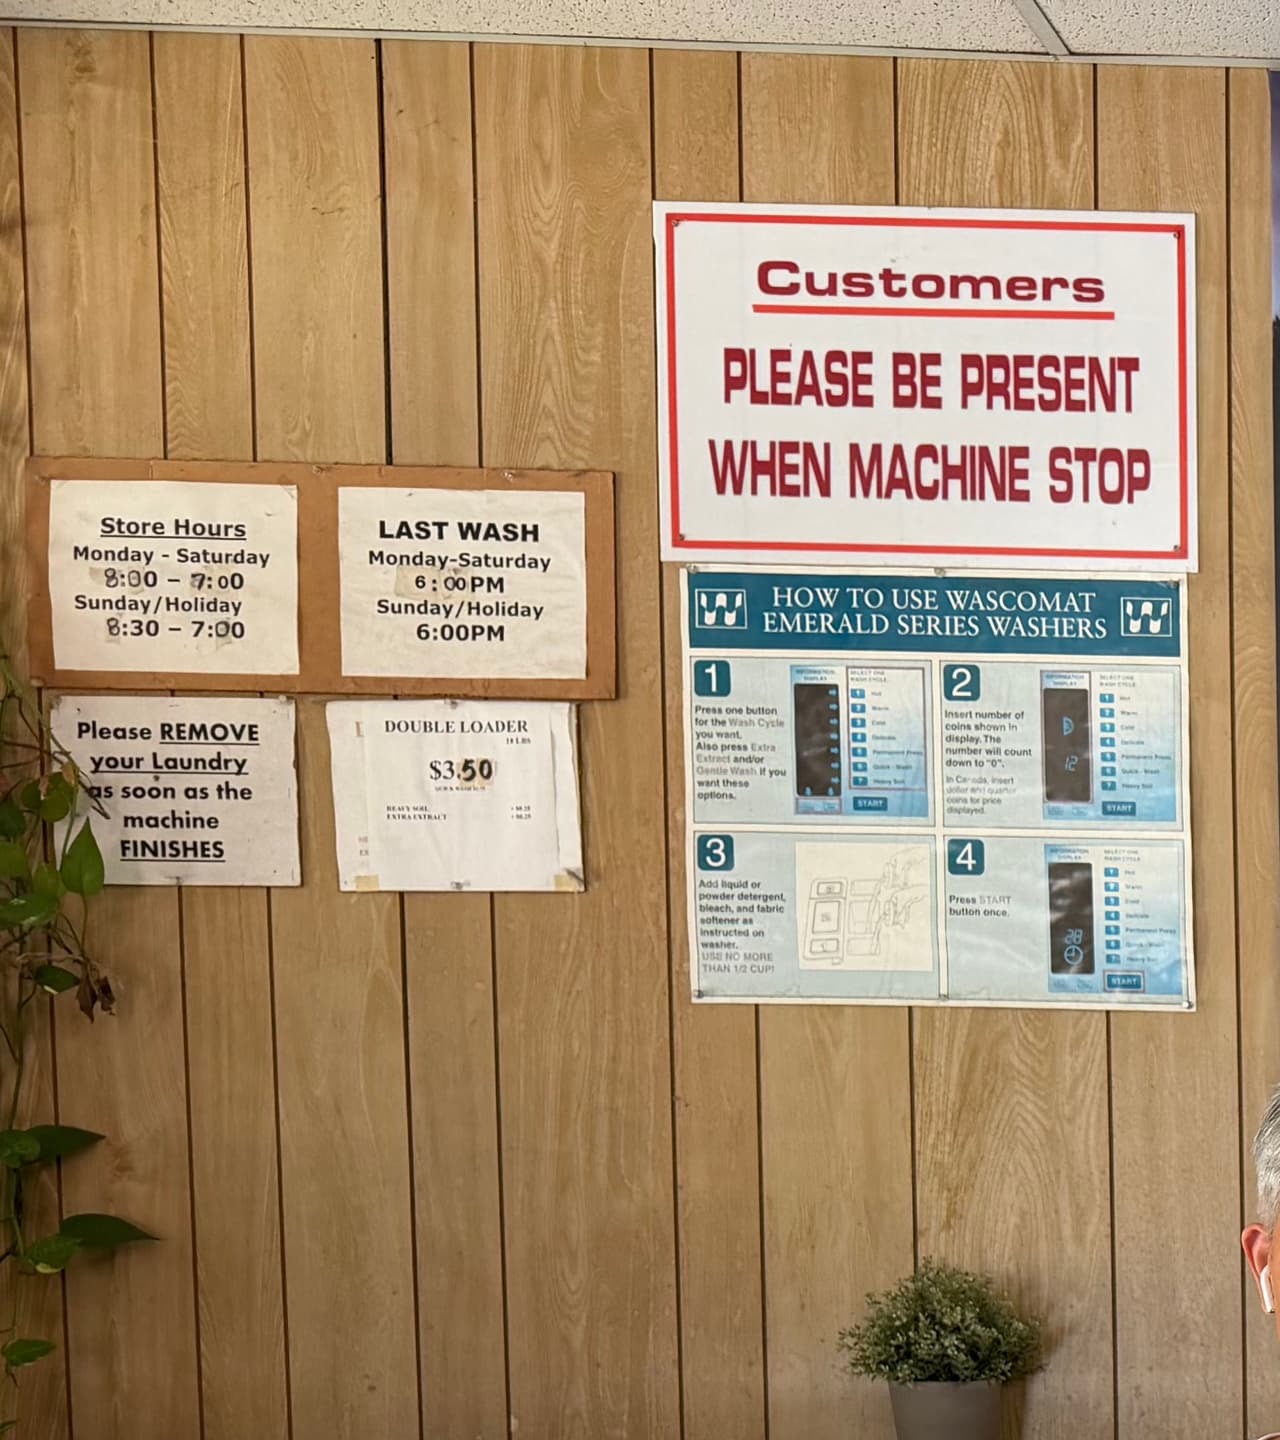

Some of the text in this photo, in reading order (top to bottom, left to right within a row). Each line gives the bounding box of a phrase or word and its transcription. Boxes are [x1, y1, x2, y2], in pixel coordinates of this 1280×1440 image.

[757, 260, 1106, 302] Customers
[723, 347, 1139, 413] PLEASE BE PRESENT
[708, 438, 1151, 504] WHEN MACHINE STOP
[101, 517, 246, 537] Store Hours
[378, 521, 540, 543] LAST WASH
[73, 546, 270, 569] Monday Saturday
[368, 550, 551, 572] Monday-Saturday
[74, 595, 243, 616] Sunday/Holiday
[376, 599, 544, 620] Sunday/Holiday
[772, 586, 1096, 614] HOW TO USE WASCOMAT
[106, 617, 245, 639] 8:30 7:00
[416, 624, 505, 642] 6:00PM
[762, 611, 1108, 640] EMERALD SERIES WASHERS
[704, 665, 719, 692] 1
[952, 669, 971, 696] 2
[77, 721, 259, 741] Please REMOVE
[385, 720, 528, 734] DOUBLE LOADER
[90, 752, 248, 775] your Laundry
[91, 781, 253, 800] as soon as the
[123, 810, 220, 830] machine
[120, 840, 225, 858] FINISHES
[705, 838, 726, 867] 3
[955, 843, 978, 871] 4
